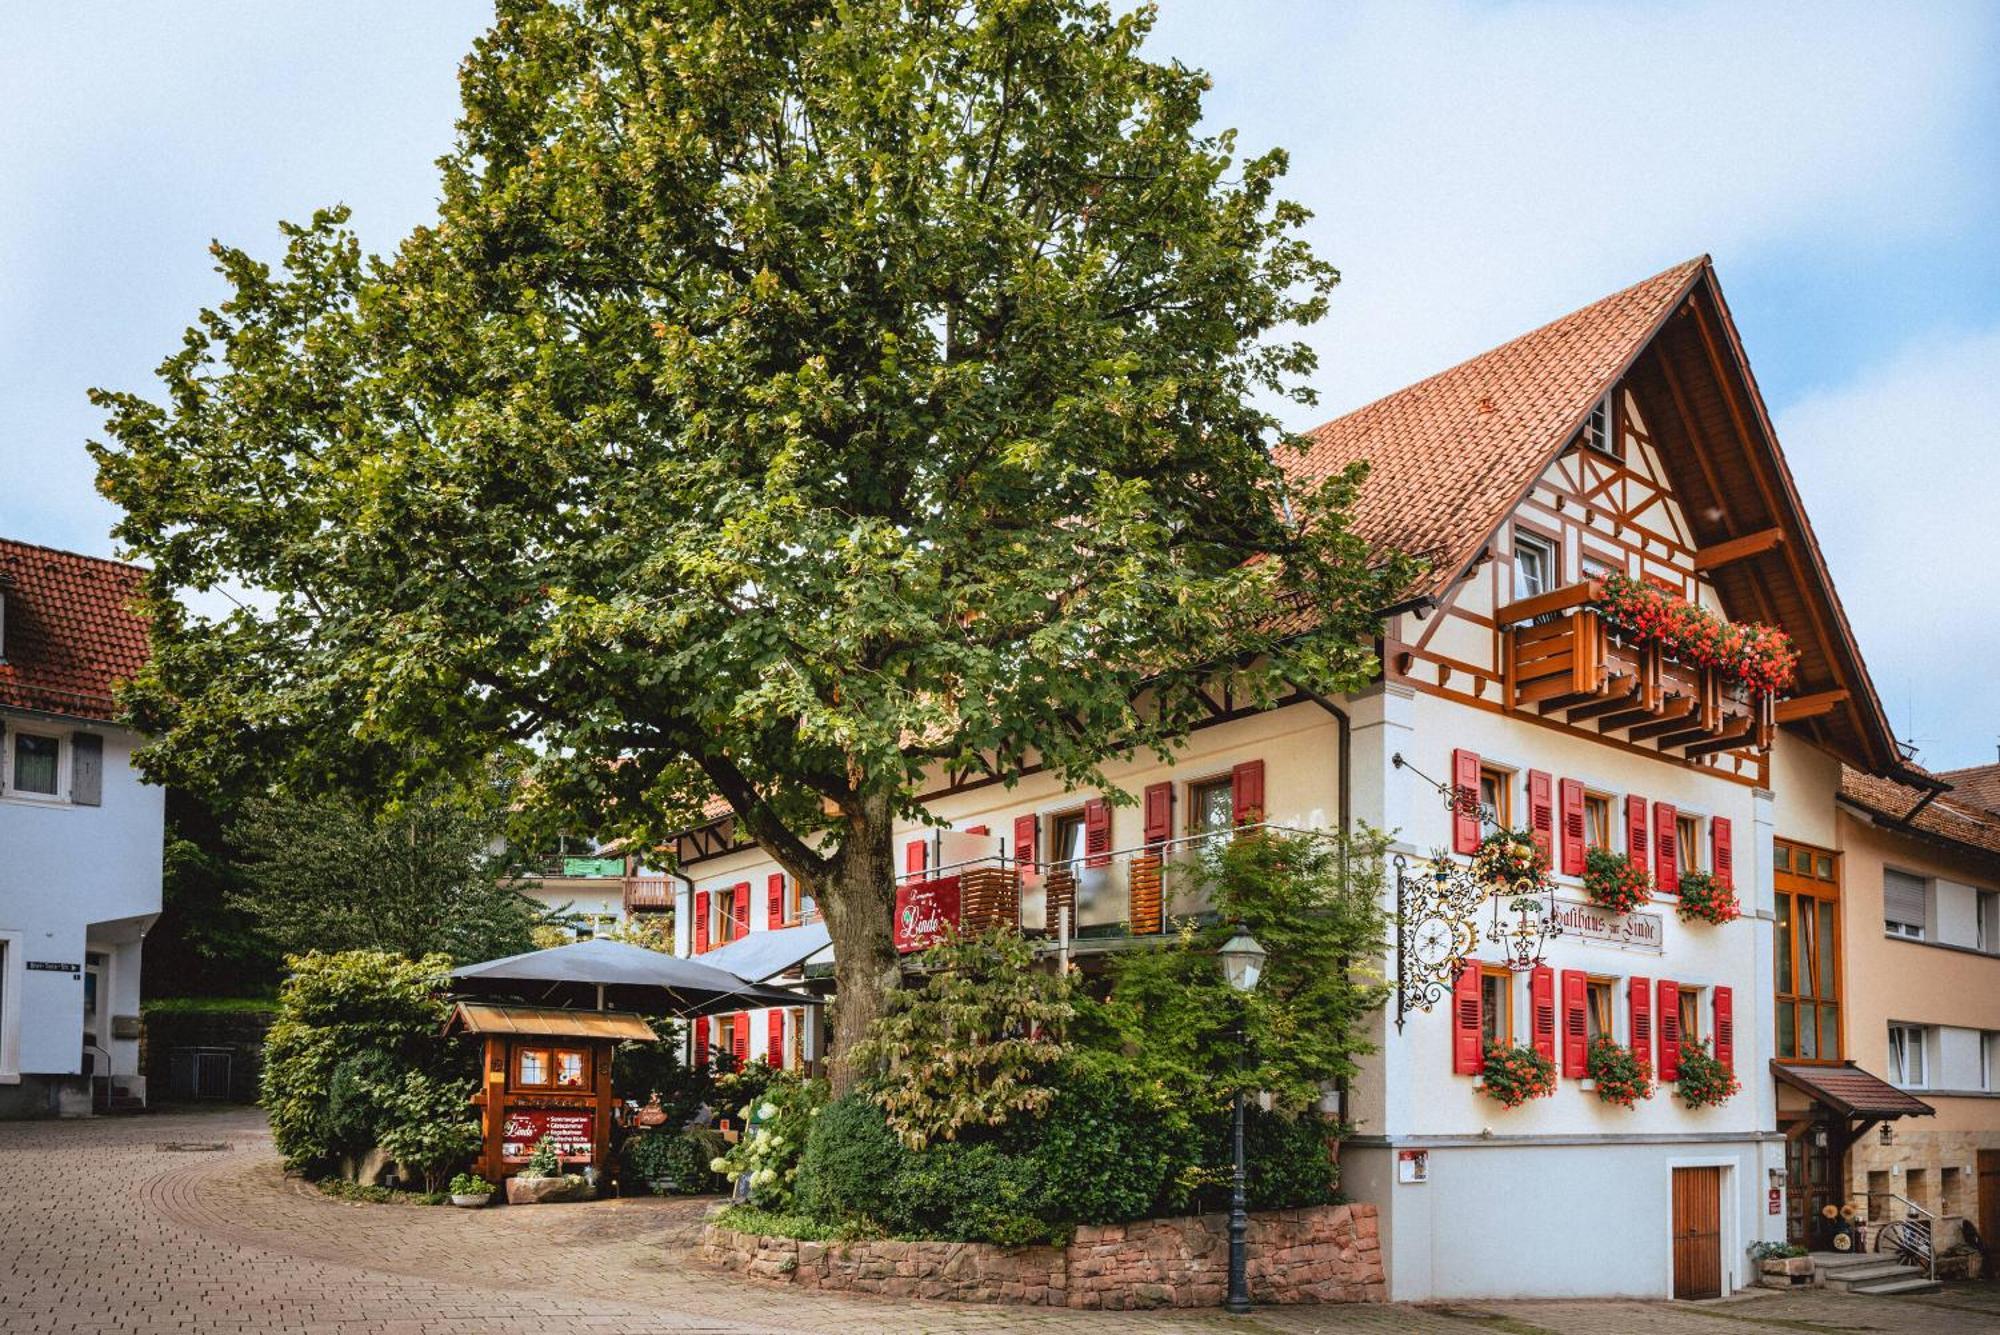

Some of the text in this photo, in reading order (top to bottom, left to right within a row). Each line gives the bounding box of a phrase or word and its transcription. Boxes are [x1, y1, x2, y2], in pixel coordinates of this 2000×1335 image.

[900, 905, 938, 938] Linde
[1622, 914, 1655, 941] Linde
[550, 1115, 589, 1123] Sommergarten
